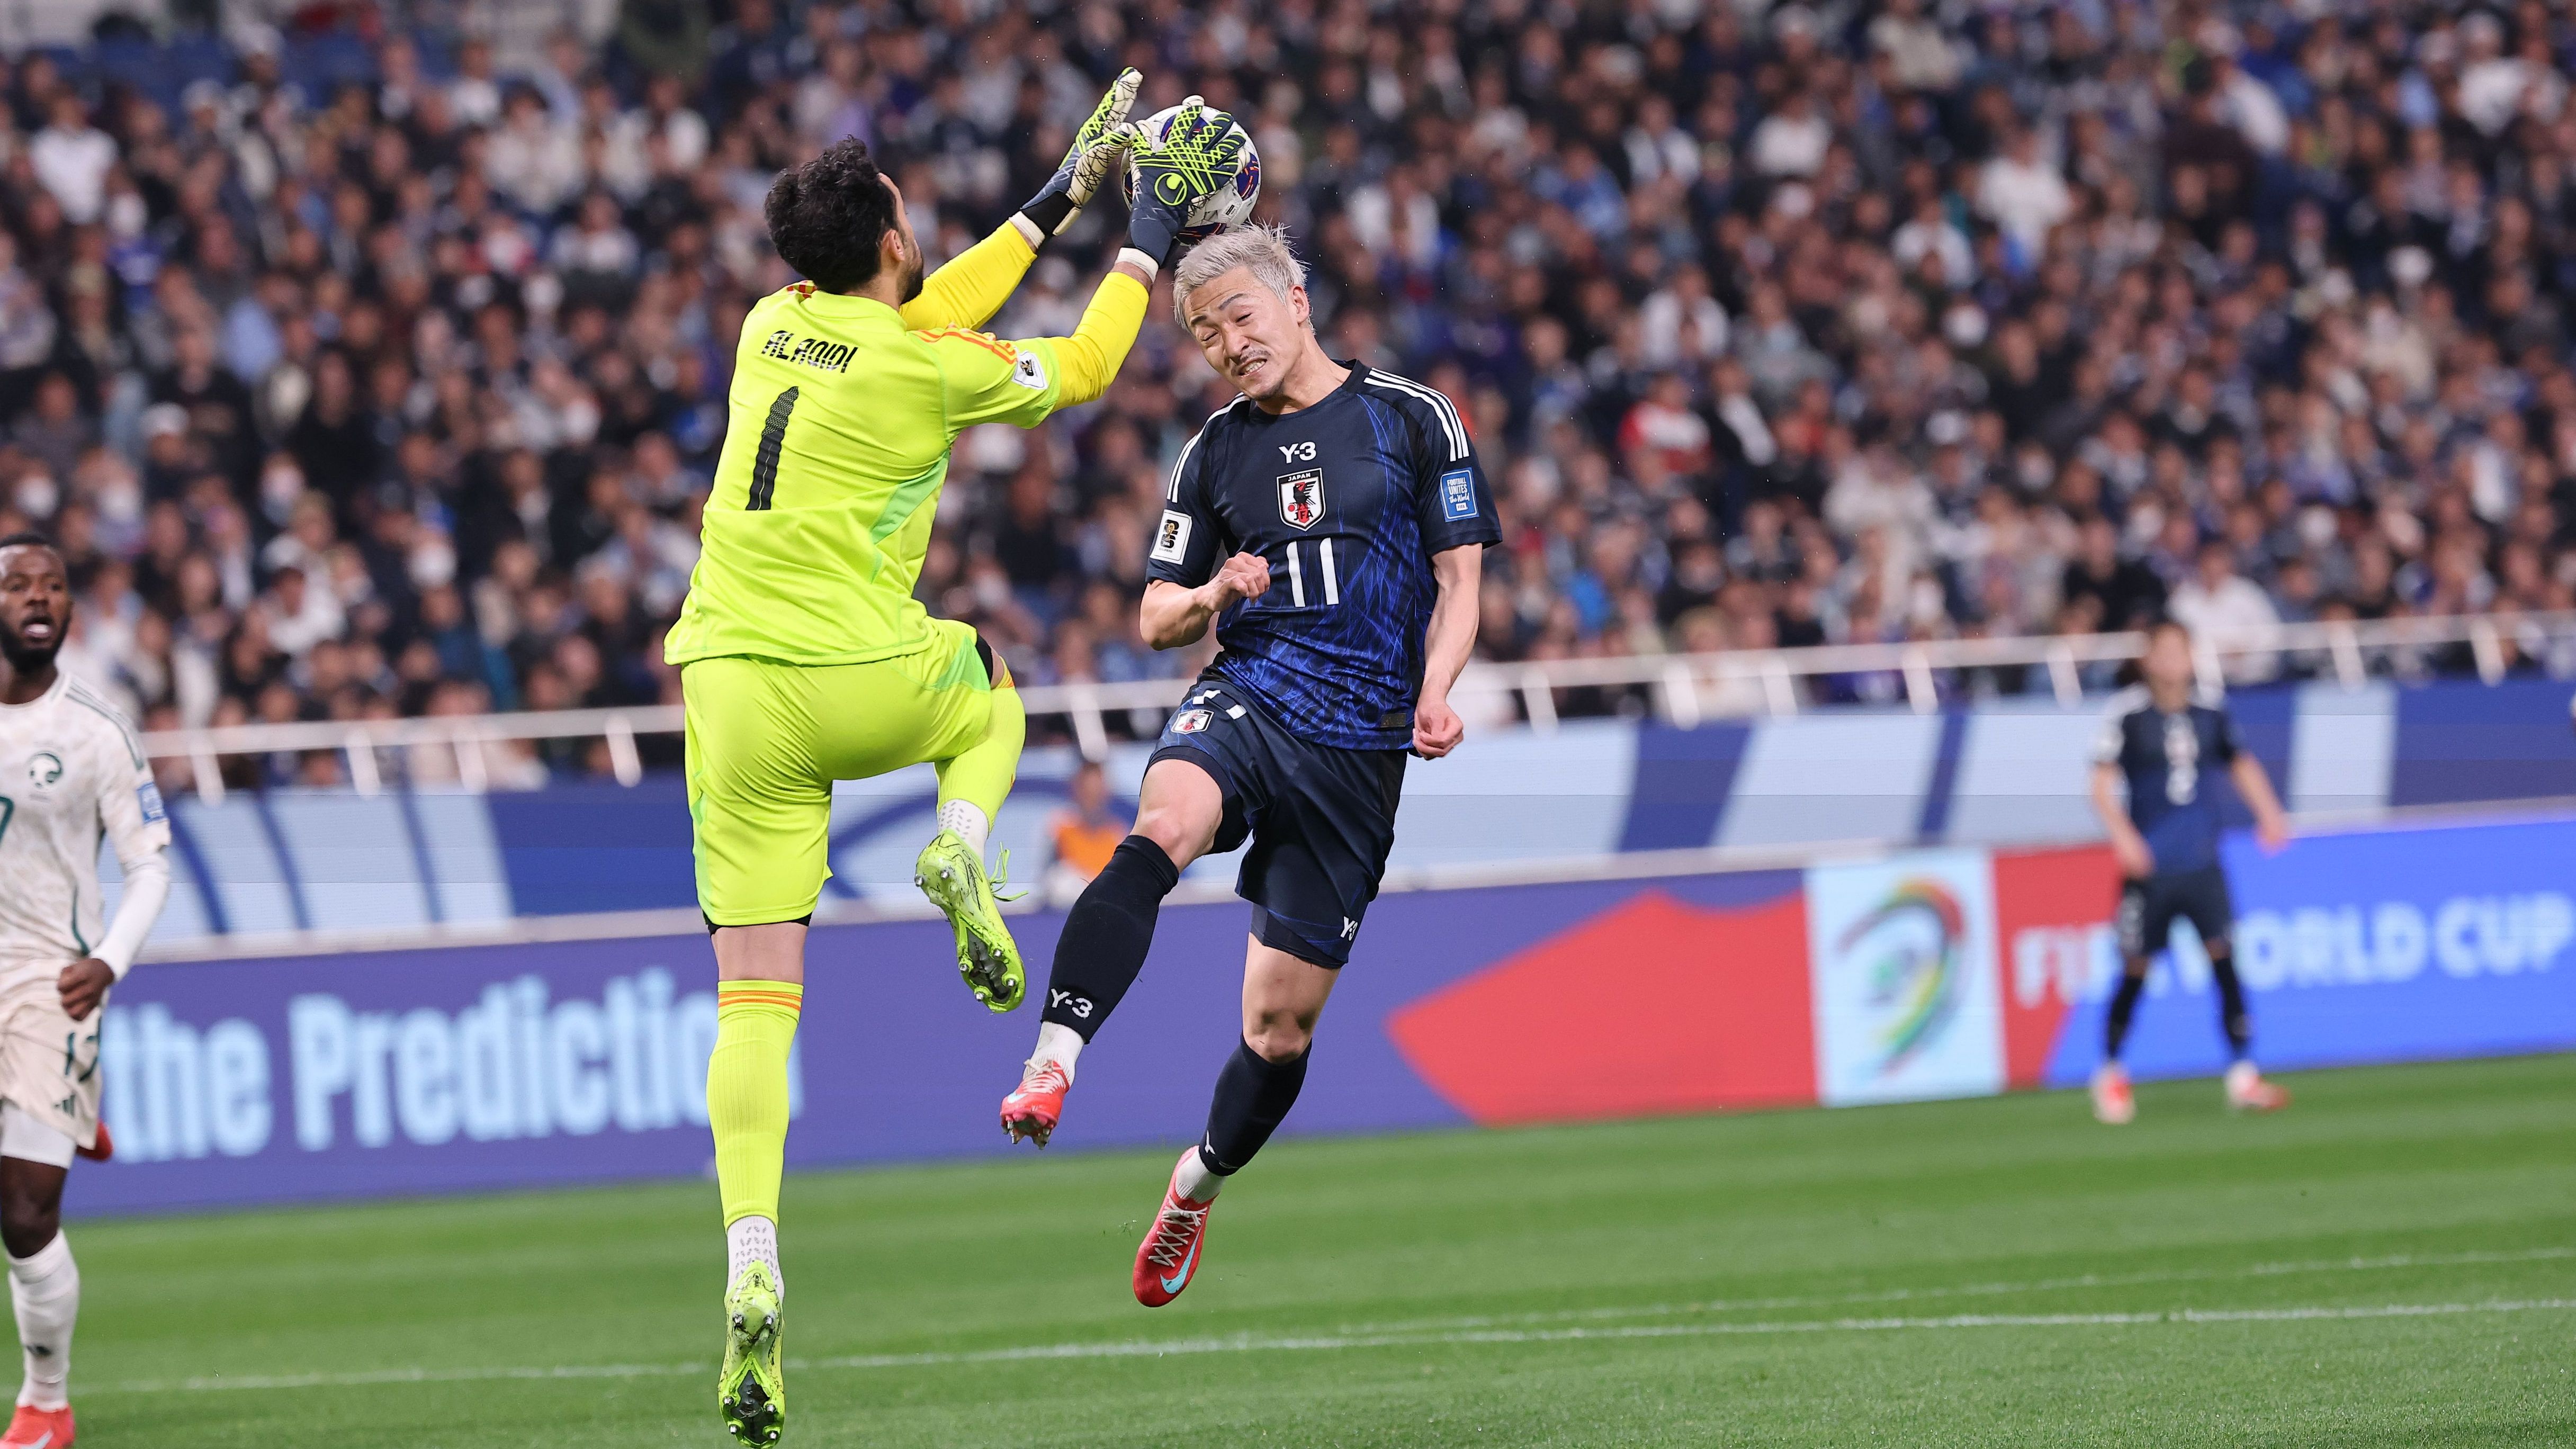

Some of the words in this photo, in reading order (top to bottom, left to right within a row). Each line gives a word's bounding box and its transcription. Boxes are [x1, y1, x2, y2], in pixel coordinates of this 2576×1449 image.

[745, 386, 799, 510] 1
[1278, 442, 1316, 464] Y-3
[1288, 473, 1311, 482] JAPAN
[1447, 477, 1467, 487] FOOTBALL
[1448, 483, 1468, 495] UNITES
[1449, 495, 1458, 503] the
[1457, 492, 1470, 502] World
[1294, 510, 1314, 520] JFA
[1286, 537, 1339, 607] 11
[1340, 916, 1358, 941] Y-3
[2012, 919, 2174, 1009] FIF
[2437, 892, 2573, 978] CUP
[1051, 988, 1093, 1019] Y-3
